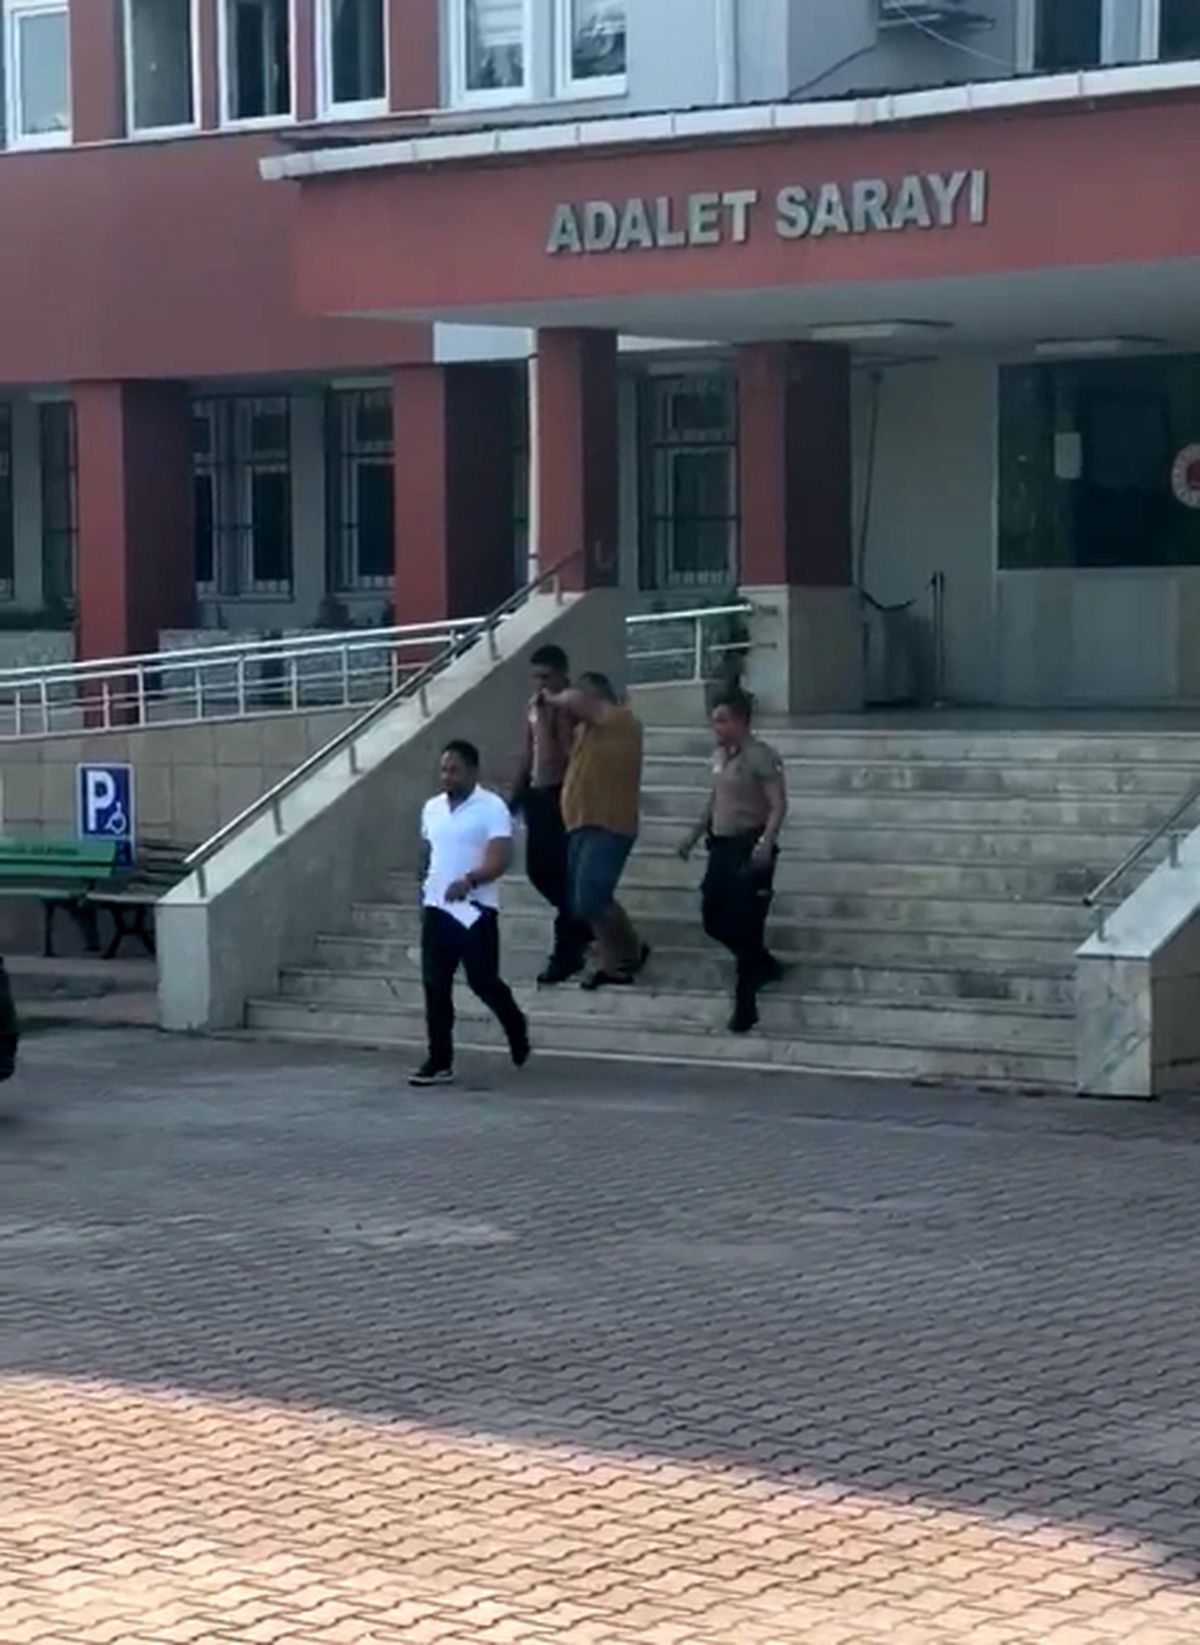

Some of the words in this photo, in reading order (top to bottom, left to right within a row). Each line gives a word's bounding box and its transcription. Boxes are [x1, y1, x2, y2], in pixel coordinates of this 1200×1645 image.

[546, 189, 758, 254] ADALET
[775, 169, 988, 240] SARAYI
[86, 769, 116, 832] P
